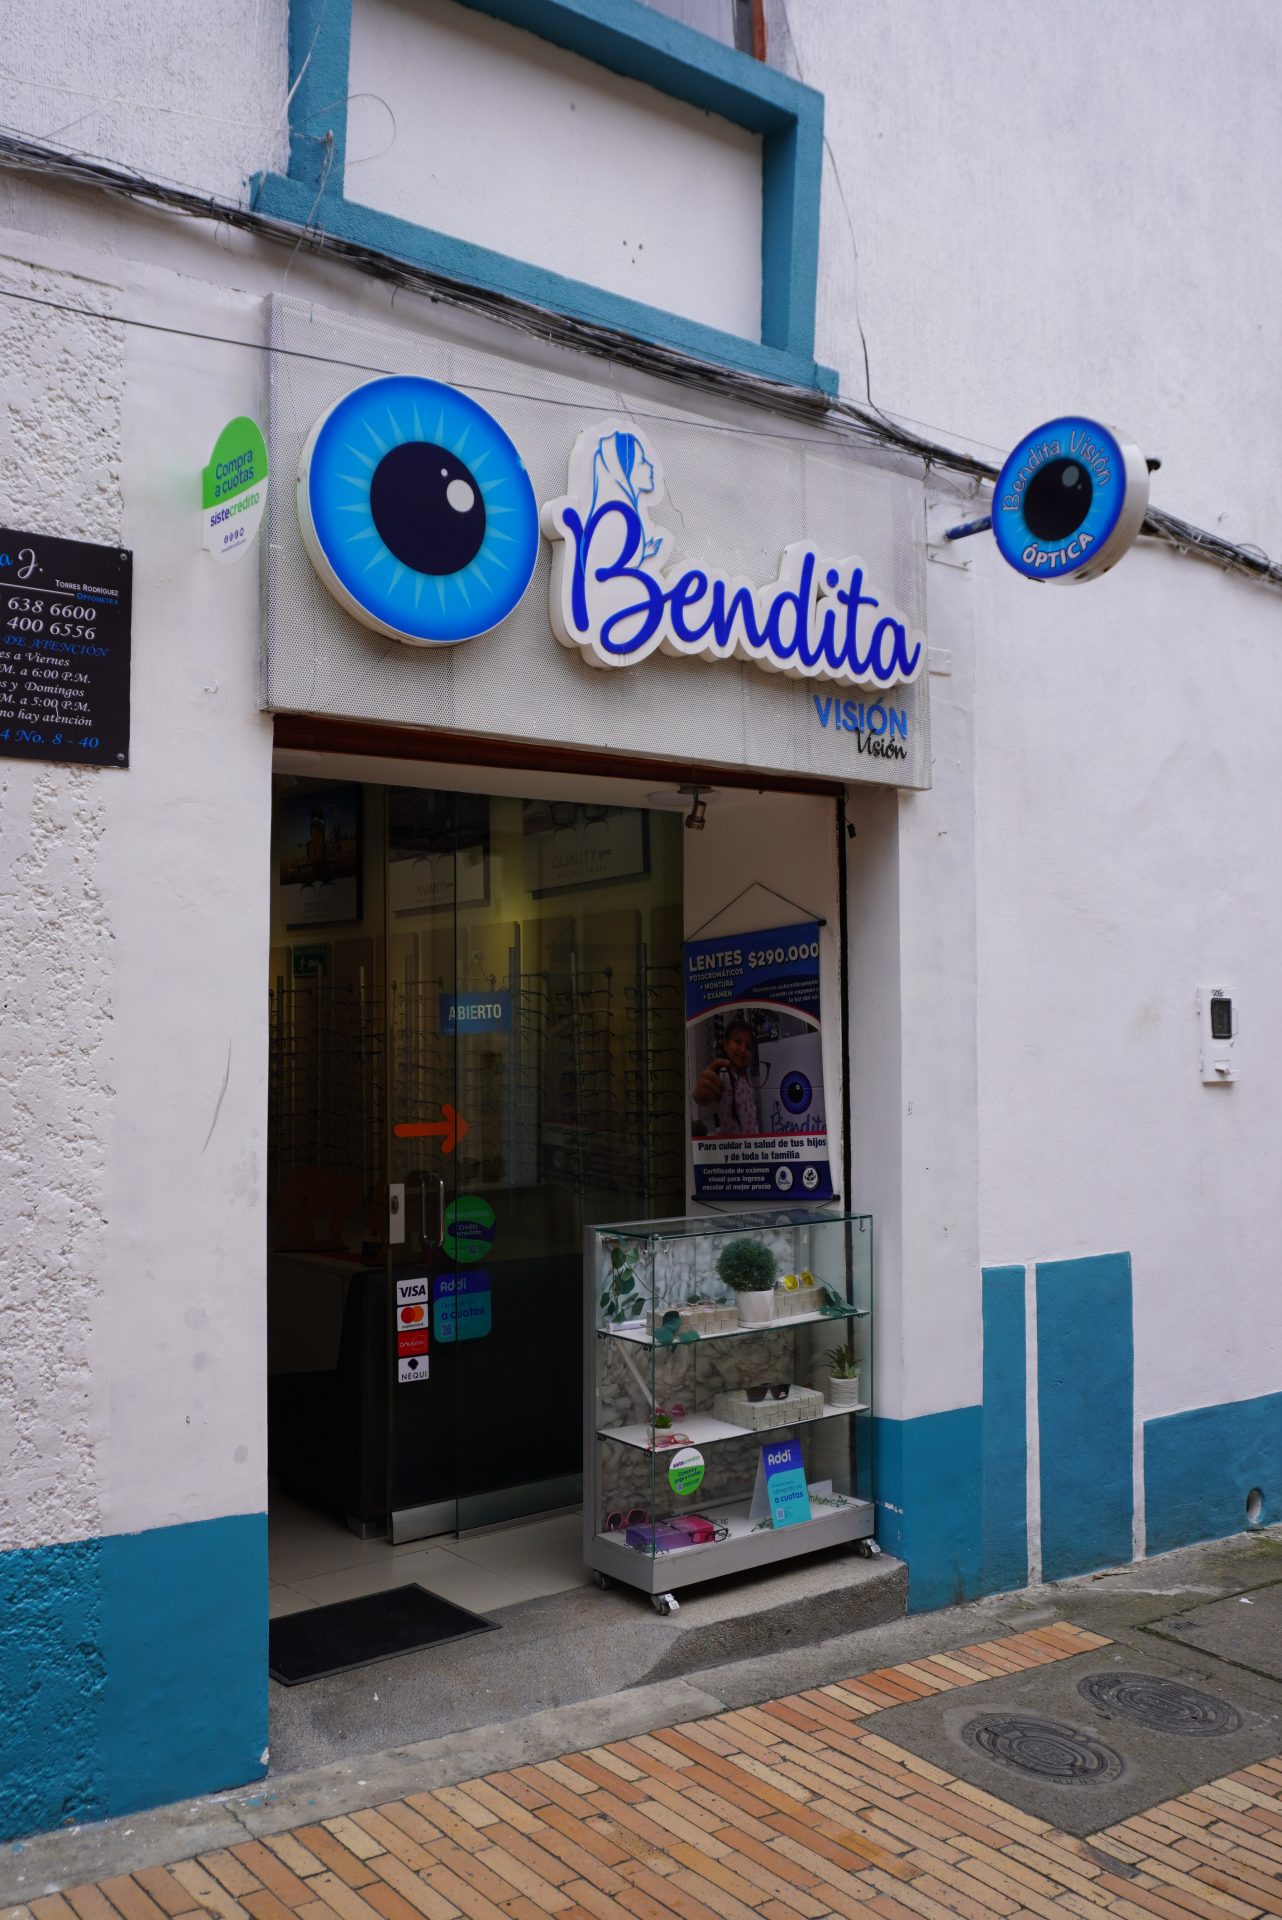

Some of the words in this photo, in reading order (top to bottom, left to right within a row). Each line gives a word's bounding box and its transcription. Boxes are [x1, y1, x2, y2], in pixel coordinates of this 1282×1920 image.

[215, 449, 253, 481] Compra
[1002, 438, 1061, 511] Bendita
[1070, 430, 1111, 486] Visión
[214, 484, 221, 498] a
[221, 466, 254, 494] cuotas
[210, 492, 260, 527] sistecrédito
[1022, 531, 1094, 568] ÓPTICA
[562, 500, 922, 681] Bendita
[7, 596, 44, 613] 638
[50, 603, 97, 621] 6600
[6, 616, 44, 632] 400
[49, 622, 97, 640] 6556
[3, 635, 27, 646] DE
[31, 639, 111, 657] ATENCIÓN
[13, 652, 21, 660] a
[25, 652, 71, 666] Viernes
[20, 668, 28, 676] a
[31, 668, 59, 679] 6:00
[61, 671, 91, 684] P.M.
[8, 681, 18, 692] y
[24, 681, 85, 698] Domingos
[20, 697, 28, 705] a
[31, 696, 59, 707] 5:00
[61, 700, 91, 712] P.M.
[17, 708, 40, 724] hay
[42, 714, 93, 726] atención
[813, 694, 908, 740] VISIÓN
[14, 728, 46, 744] No.
[52, 732, 63, 744] 8
[79, 735, 100, 748] 40
[855, 726, 908, 760] Visión
[688, 949, 743, 972] LENTES
[747, 942, 819, 969] $290.000
[689, 968, 744, 982] FOTOCROMÁTICOS
[704, 979, 735, 991] MONTURA
[447, 1003, 502, 1021] ABIERTO
[698, 1142, 717, 1151] Para
[718, 1140, 742, 1150] cuidar
[744, 1141, 752, 1149] la
[754, 1140, 776, 1149] salud
[778, 1138, 789, 1148] de
[791, 1137, 805, 1147] tus
[807, 1136, 827, 1149] hijos
[724, 1153, 729, 1162] y
[730, 1152, 740, 1161] de
[742, 1152, 759, 1160] toda
[761, 1151, 769, 1160] la
[771, 1150, 800, 1160] familia
[732, 1183, 750, 1191] mejor
[751, 1182, 771, 1191] precio
[398, 1284, 426, 1298] VISA
[440, 1276, 467, 1293] Addi
[441, 1312, 448, 1320] a
[450, 1305, 486, 1319] cuotas
[401, 1371, 428, 1381] NEQUI
[767, 1448, 792, 1466] Addi
[780, 1491, 804, 1502] cuotas
